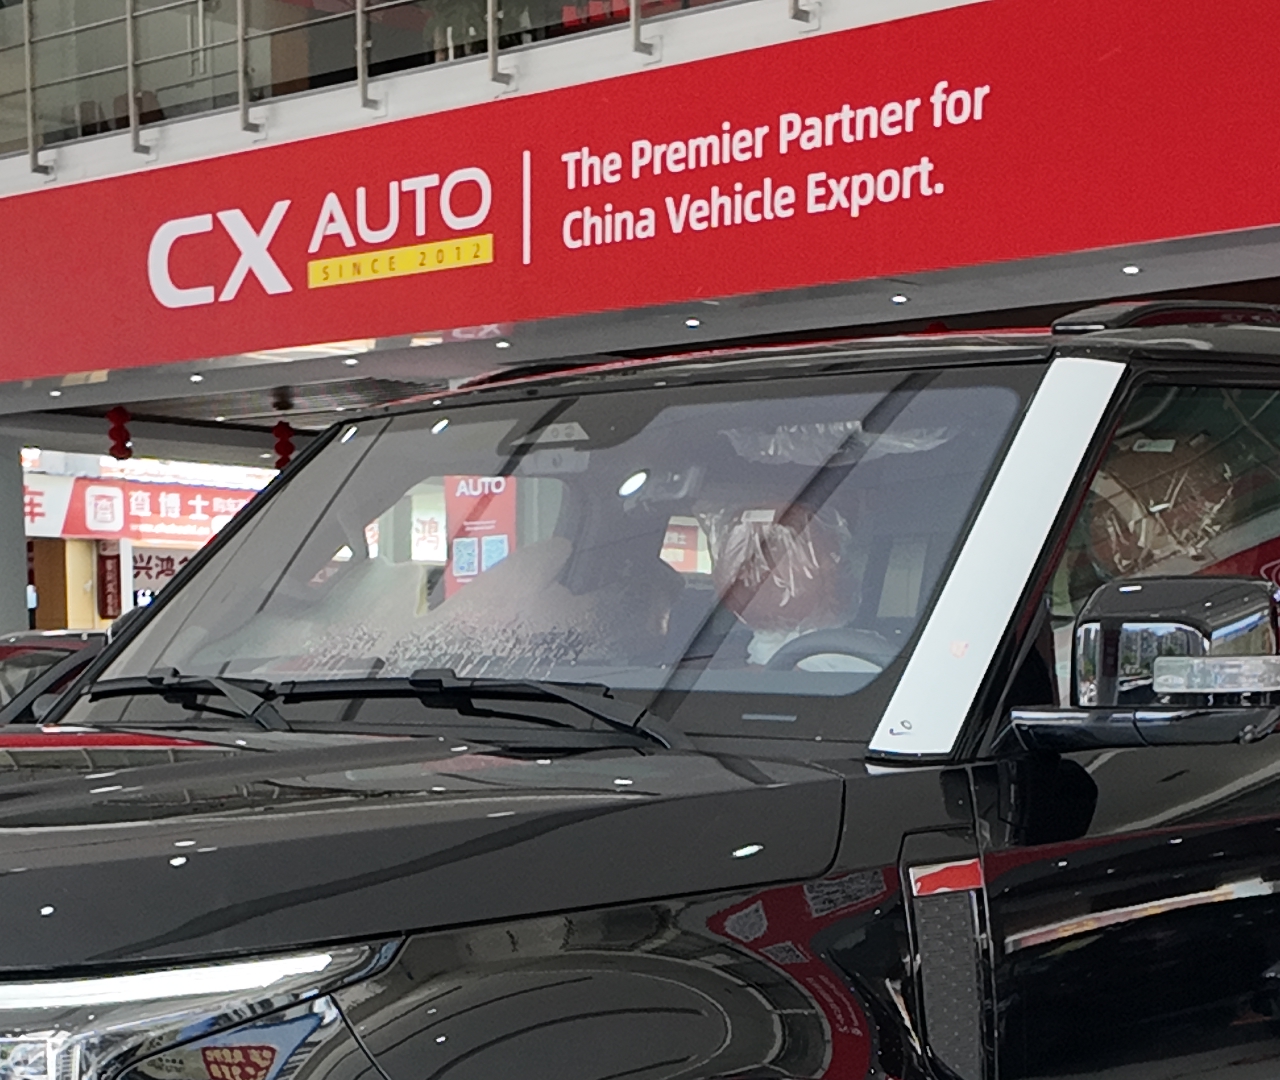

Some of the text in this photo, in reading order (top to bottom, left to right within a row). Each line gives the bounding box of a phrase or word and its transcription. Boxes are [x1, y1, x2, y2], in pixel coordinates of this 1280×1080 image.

[561, 81, 991, 190] The Premier Partner for
[147, 167, 492, 309] CX AUTO
[562, 157, 944, 249] China Vehicle Export.
[322, 242, 481, 281] SINCE 2012
[455, 476, 506, 497] AUTO
